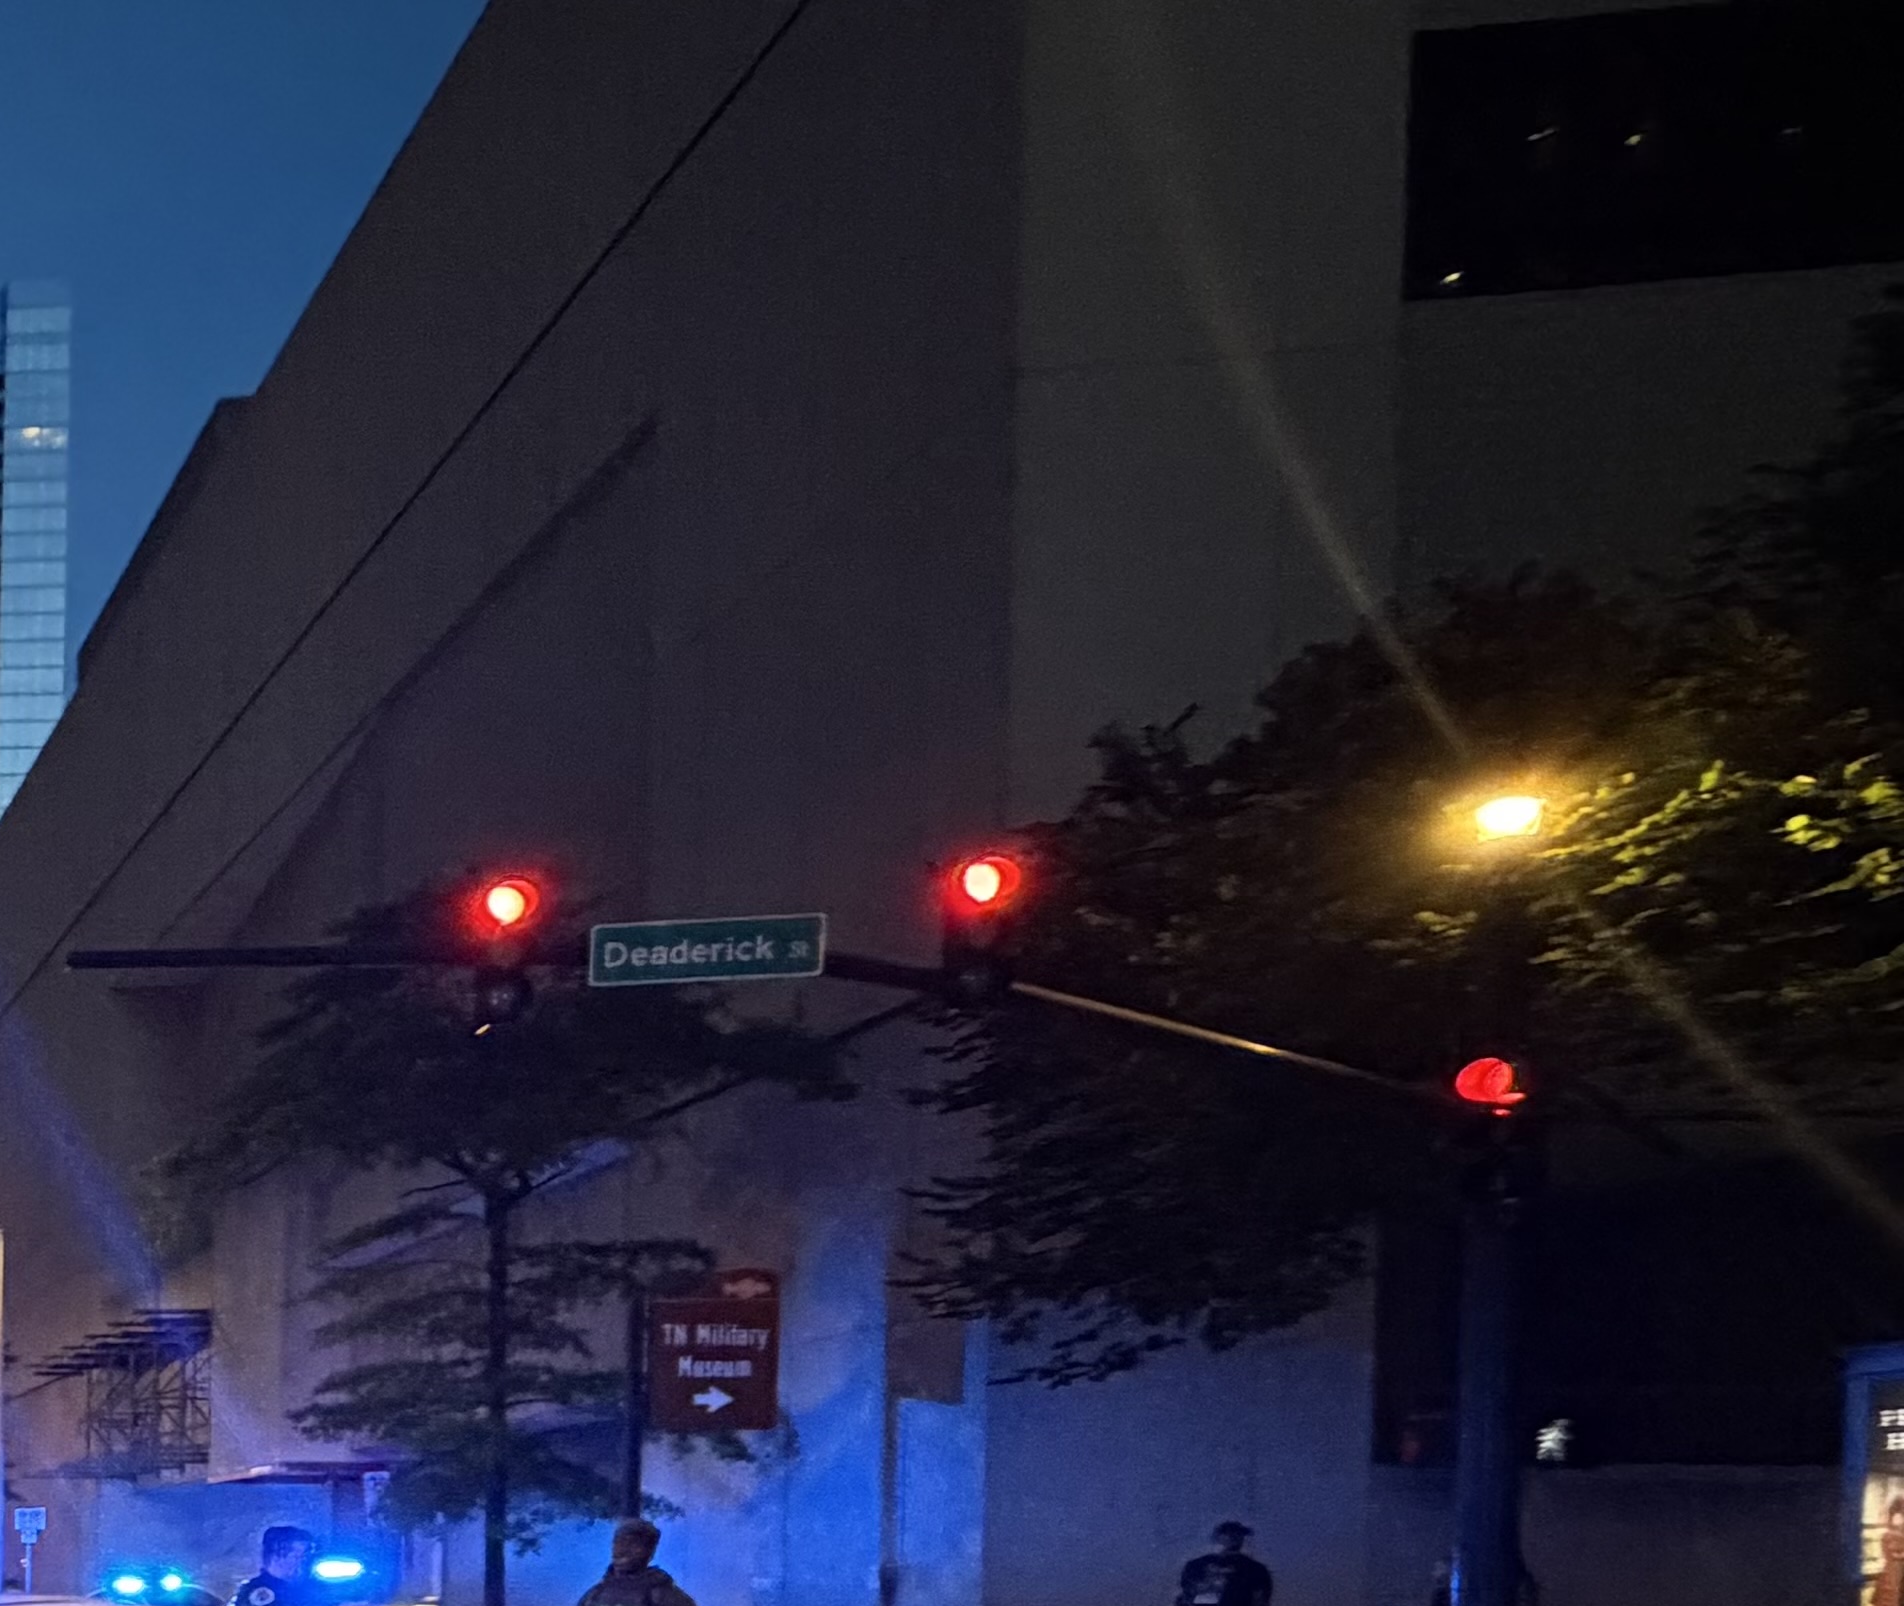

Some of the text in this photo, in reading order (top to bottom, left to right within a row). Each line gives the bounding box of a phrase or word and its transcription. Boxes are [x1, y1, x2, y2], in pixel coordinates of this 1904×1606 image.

[603, 935, 774, 968] Deaderick
[661, 1323, 770, 1351] TN Military
[678, 1355, 752, 1379] Museum
